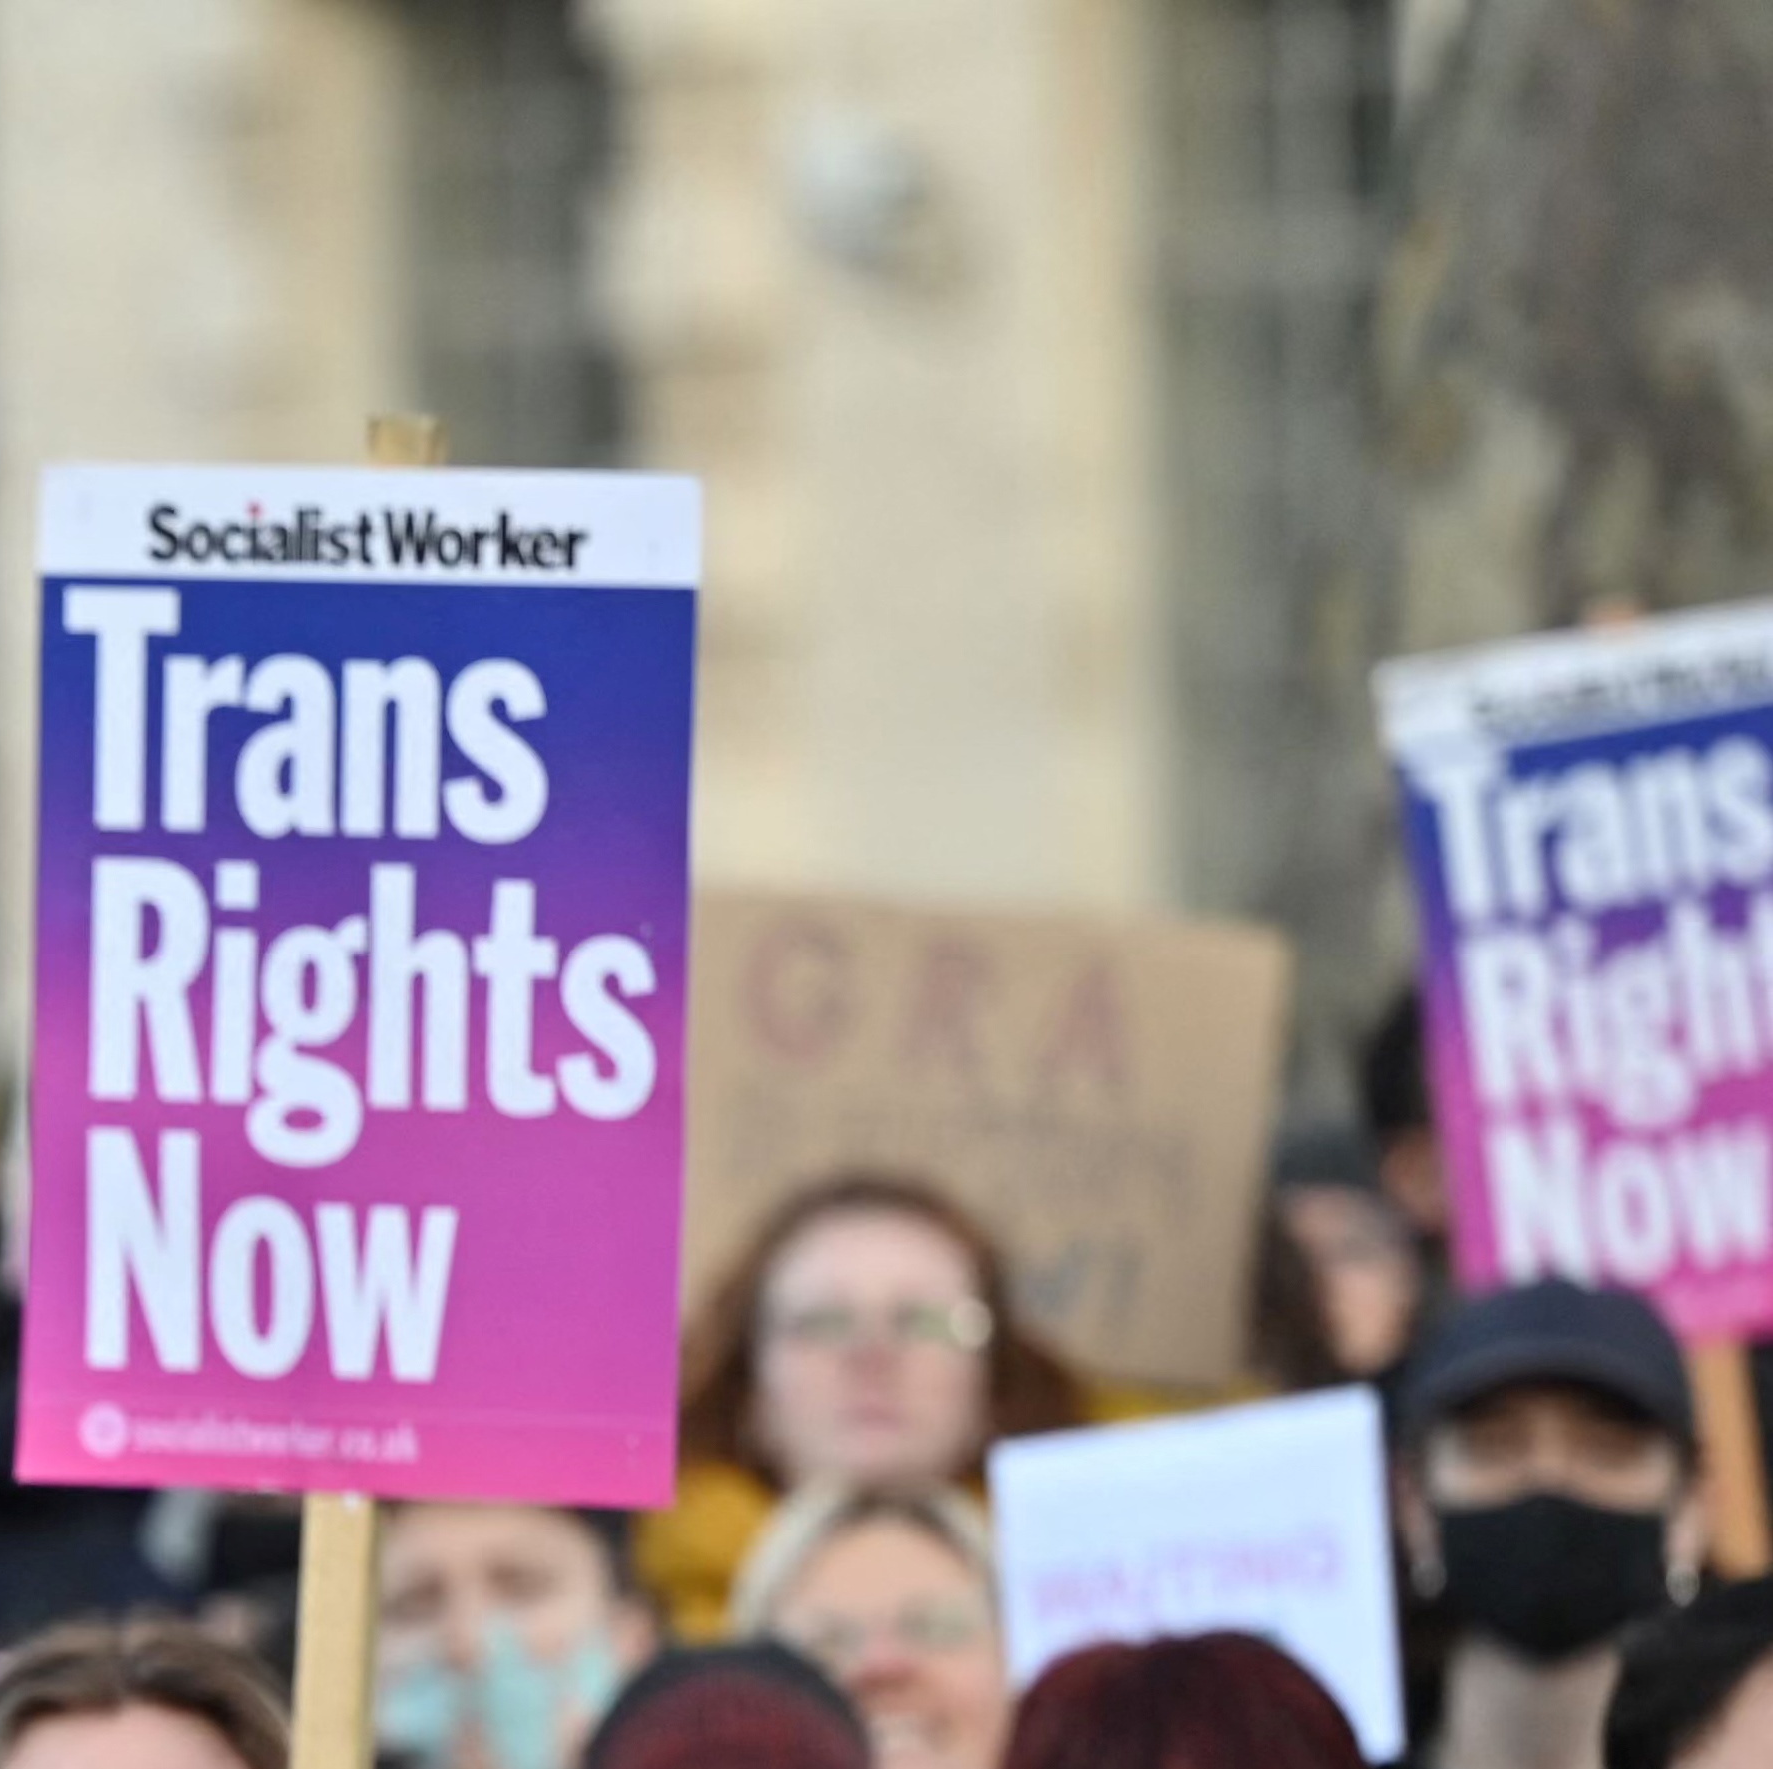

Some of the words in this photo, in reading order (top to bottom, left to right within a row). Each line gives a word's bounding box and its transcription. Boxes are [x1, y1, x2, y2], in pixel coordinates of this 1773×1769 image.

[145, 501, 374, 568] Socialist
[382, 510, 589, 573] Worker
[60, 583, 550, 846] Trans
[1408, 737, 1773, 922] Trans
[88, 853, 657, 1170] Rights
[1458, 892, 1773, 1132] Righ
[83, 1124, 458, 1383] Now
[1487, 1115, 1773, 1291] Now
